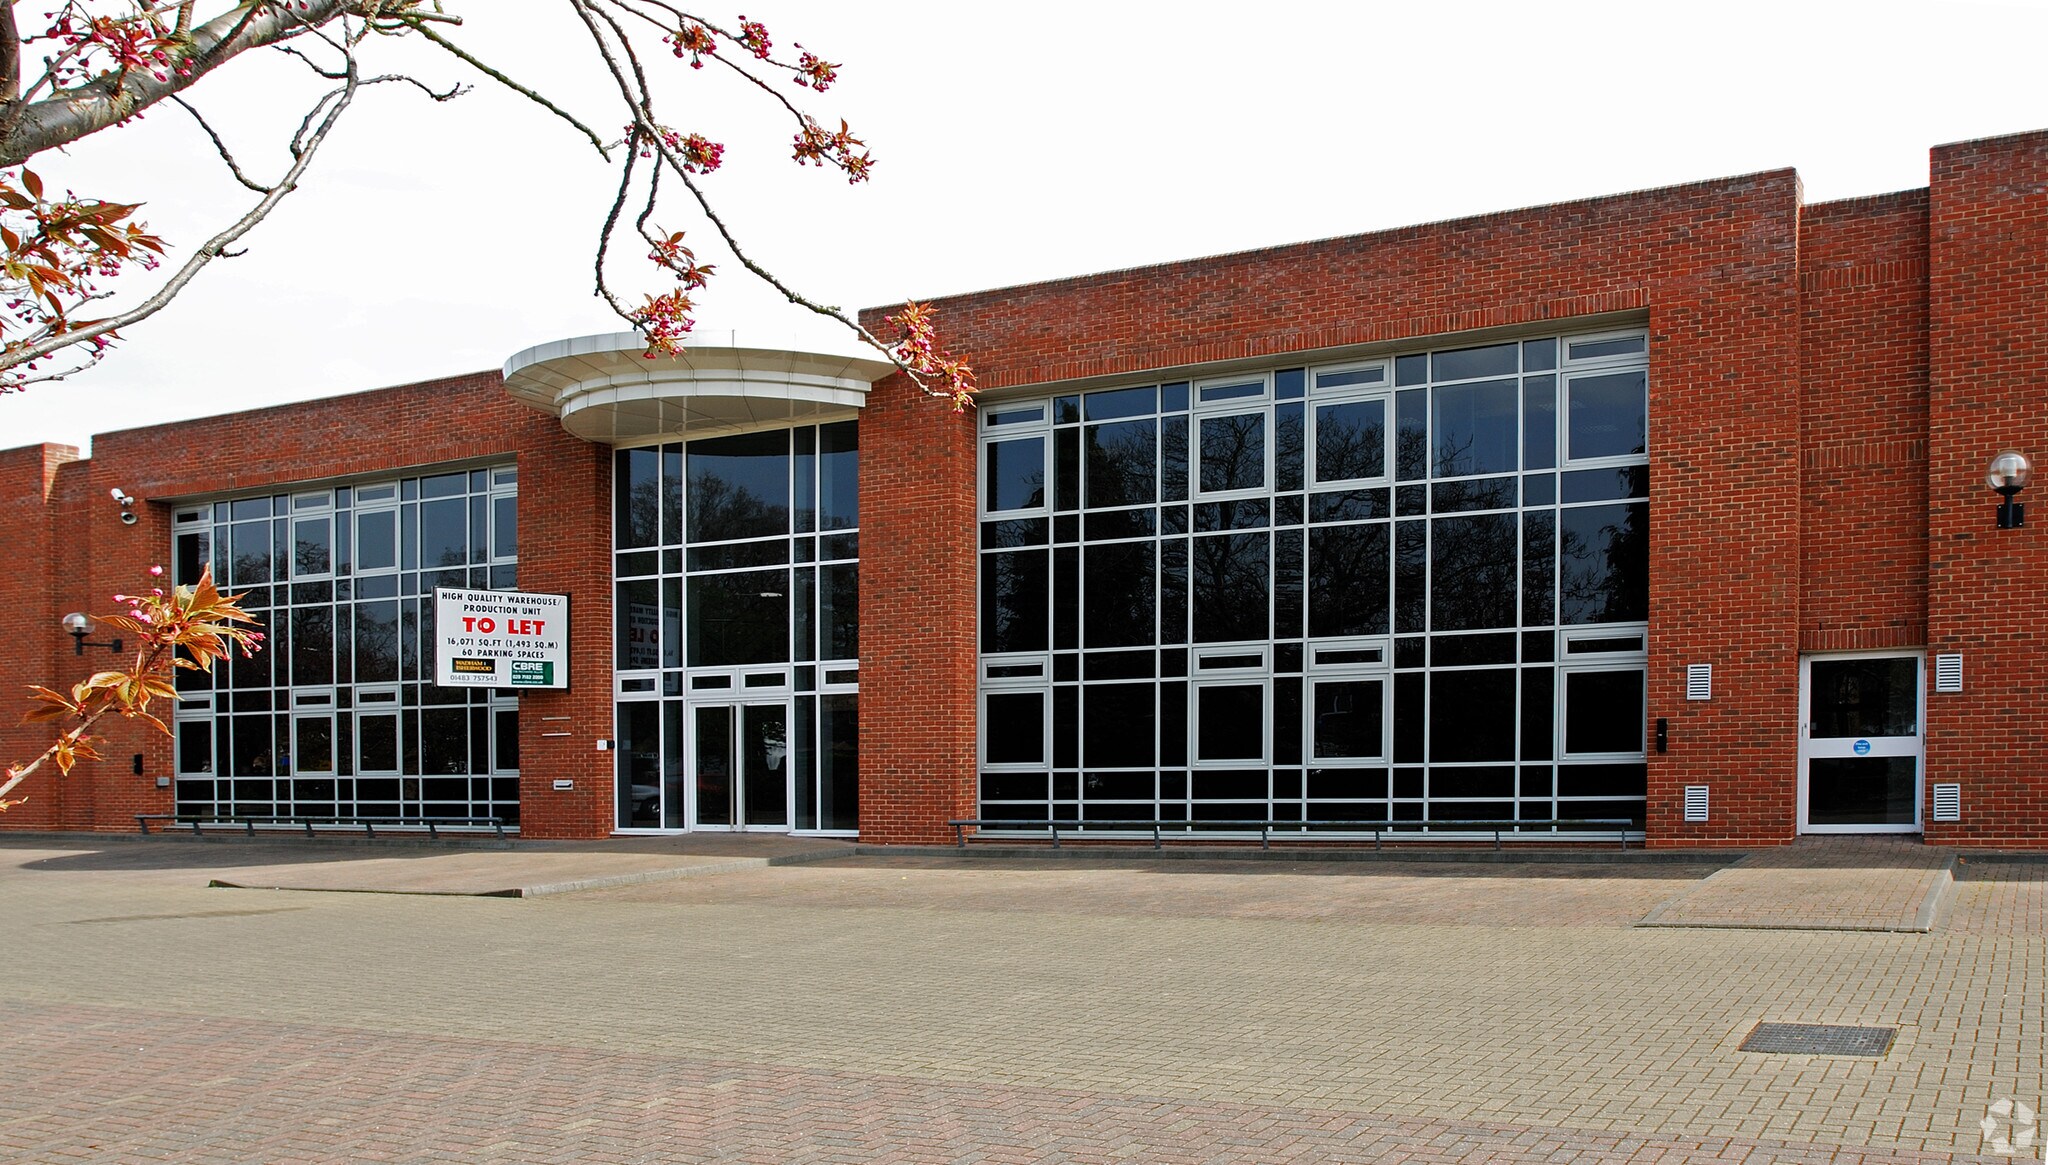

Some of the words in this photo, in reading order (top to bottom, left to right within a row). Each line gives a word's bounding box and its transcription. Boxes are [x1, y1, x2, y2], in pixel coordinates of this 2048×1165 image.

[442, 592, 463, 600] HIGH
[468, 594, 503, 603] QUALITY
[507, 596, 561, 606] WAREHOUSE/
[464, 604, 518, 614] PRODUCTION
[462, 617, 496, 634] TO
[508, 619, 545, 636] LET
[448, 638, 474, 646] 16,071
[478, 638, 502, 646] SQ.FT
[505, 639, 530, 648] (1,493
[534, 641, 558, 650] SQ.M)
[477, 650, 513, 658] PARKING
[517, 650, 544, 658] SPACES
[513, 662, 543, 670] CBRE
